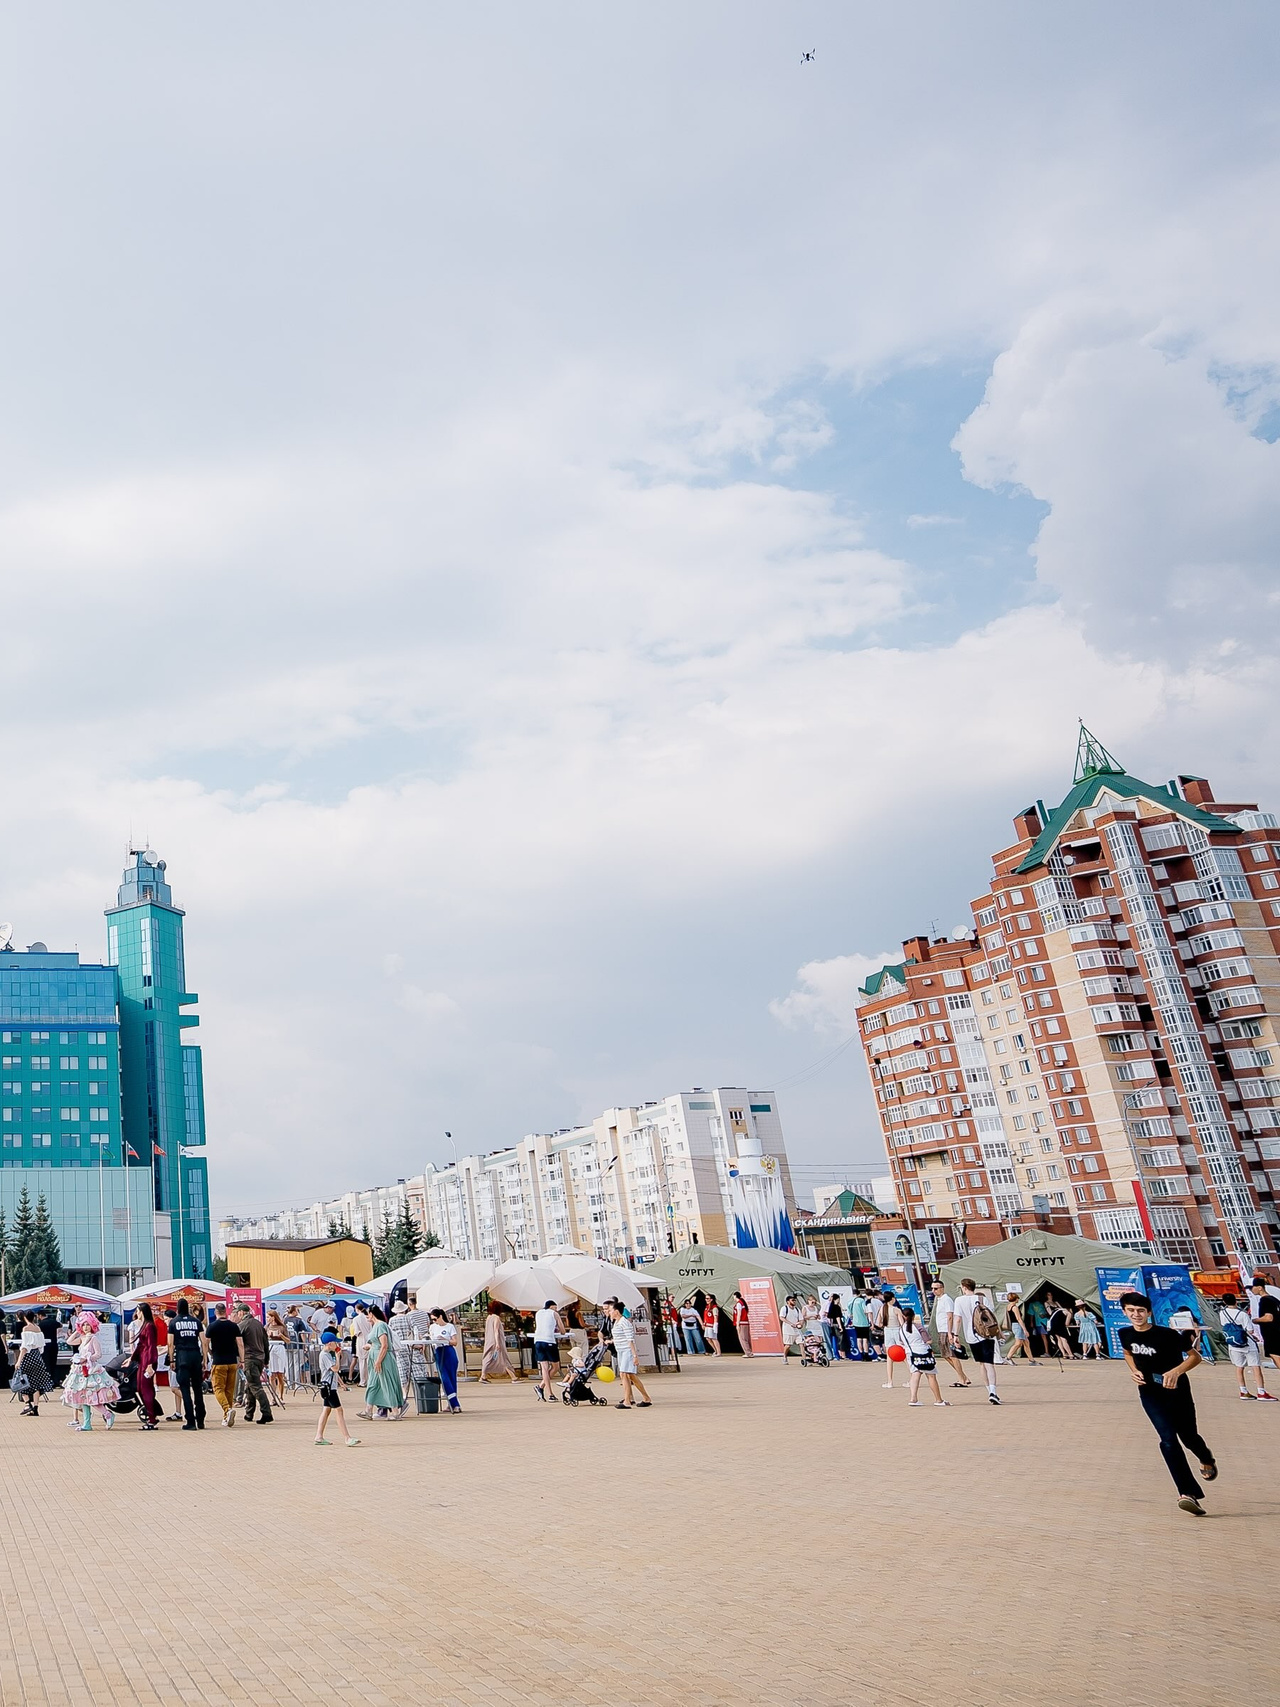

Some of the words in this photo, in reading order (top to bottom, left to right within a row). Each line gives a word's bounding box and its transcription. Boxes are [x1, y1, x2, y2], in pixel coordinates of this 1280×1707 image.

[794, 1215, 866, 1227] СКАНДИНАВИЯ
[1016, 1256, 1066, 1267] СУРГУТ
[678, 1269, 715, 1277] СУРГУТ
[175, 1321, 198, 1330] ОМОН
[1130, 1342, 1157, 1356] Dior
